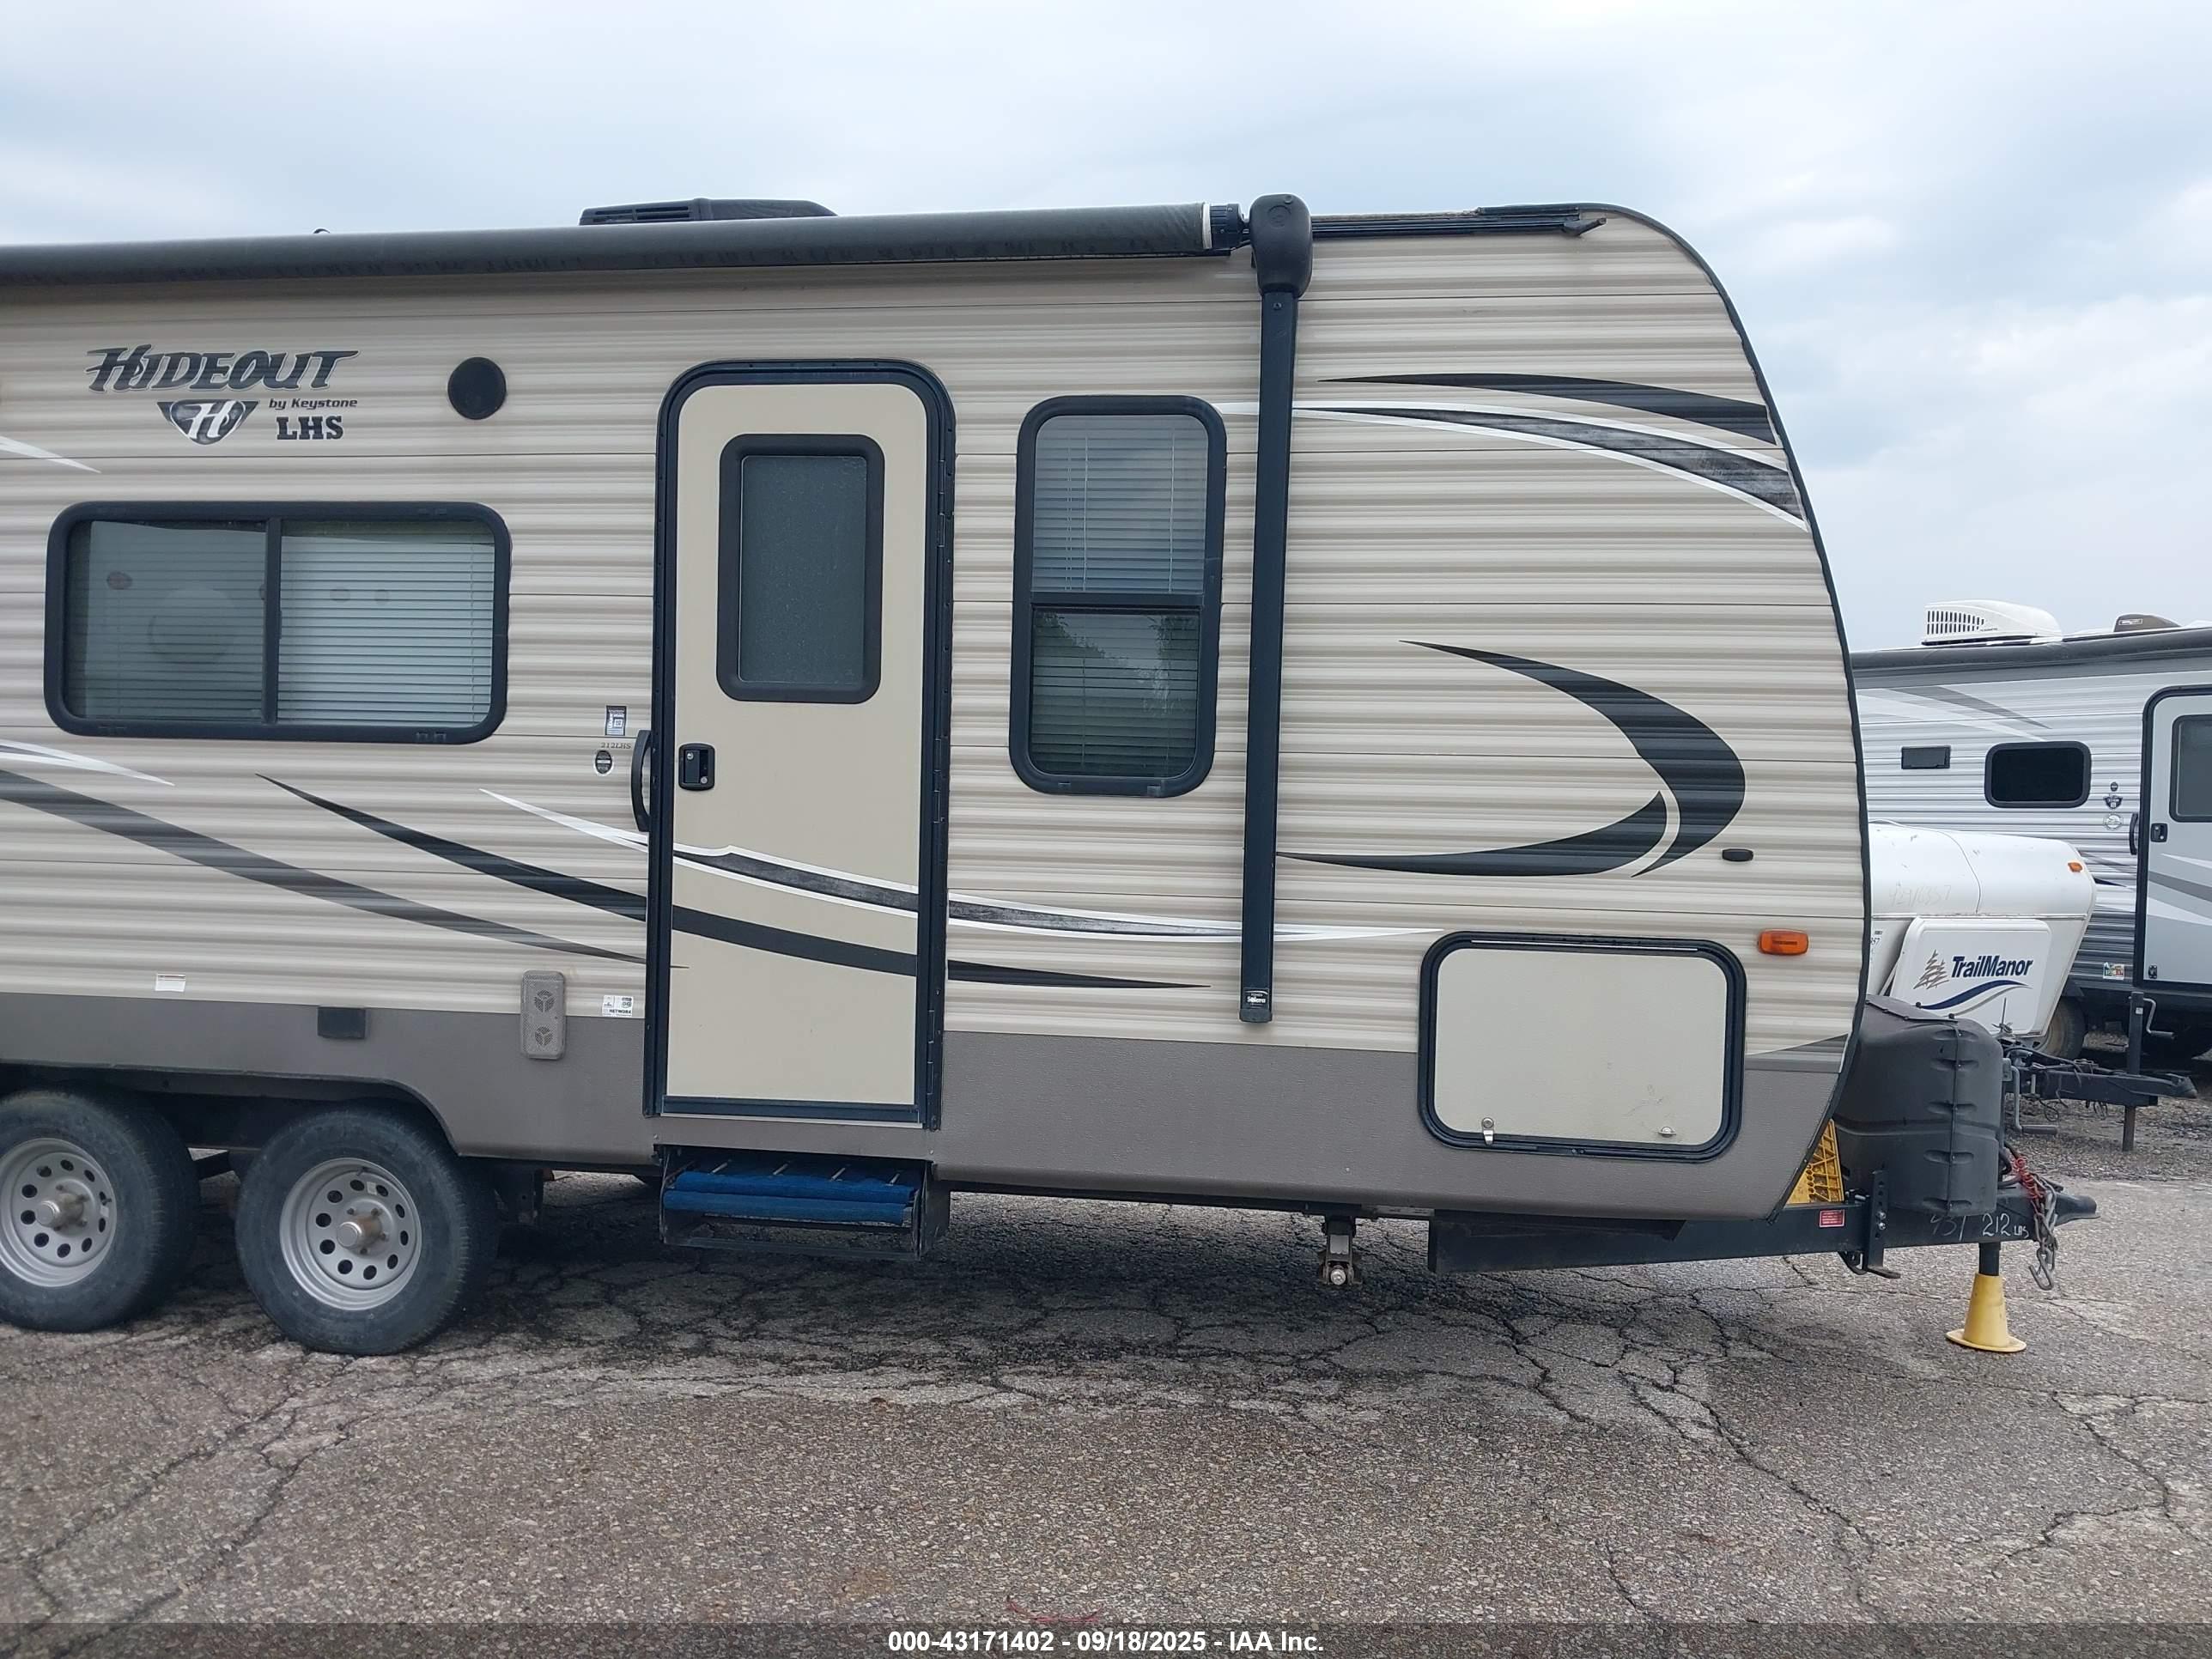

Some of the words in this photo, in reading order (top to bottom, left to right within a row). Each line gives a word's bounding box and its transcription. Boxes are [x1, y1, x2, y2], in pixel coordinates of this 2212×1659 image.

[86, 343, 359, 392] HIDEOUT
[269, 398, 286, 410] by
[290, 398, 358, 410] Keystone
[276, 416, 343, 440] LHS
[1951, 955, 2034, 978] TrailManor
[1982, 1212, 2011, 1237] 212
